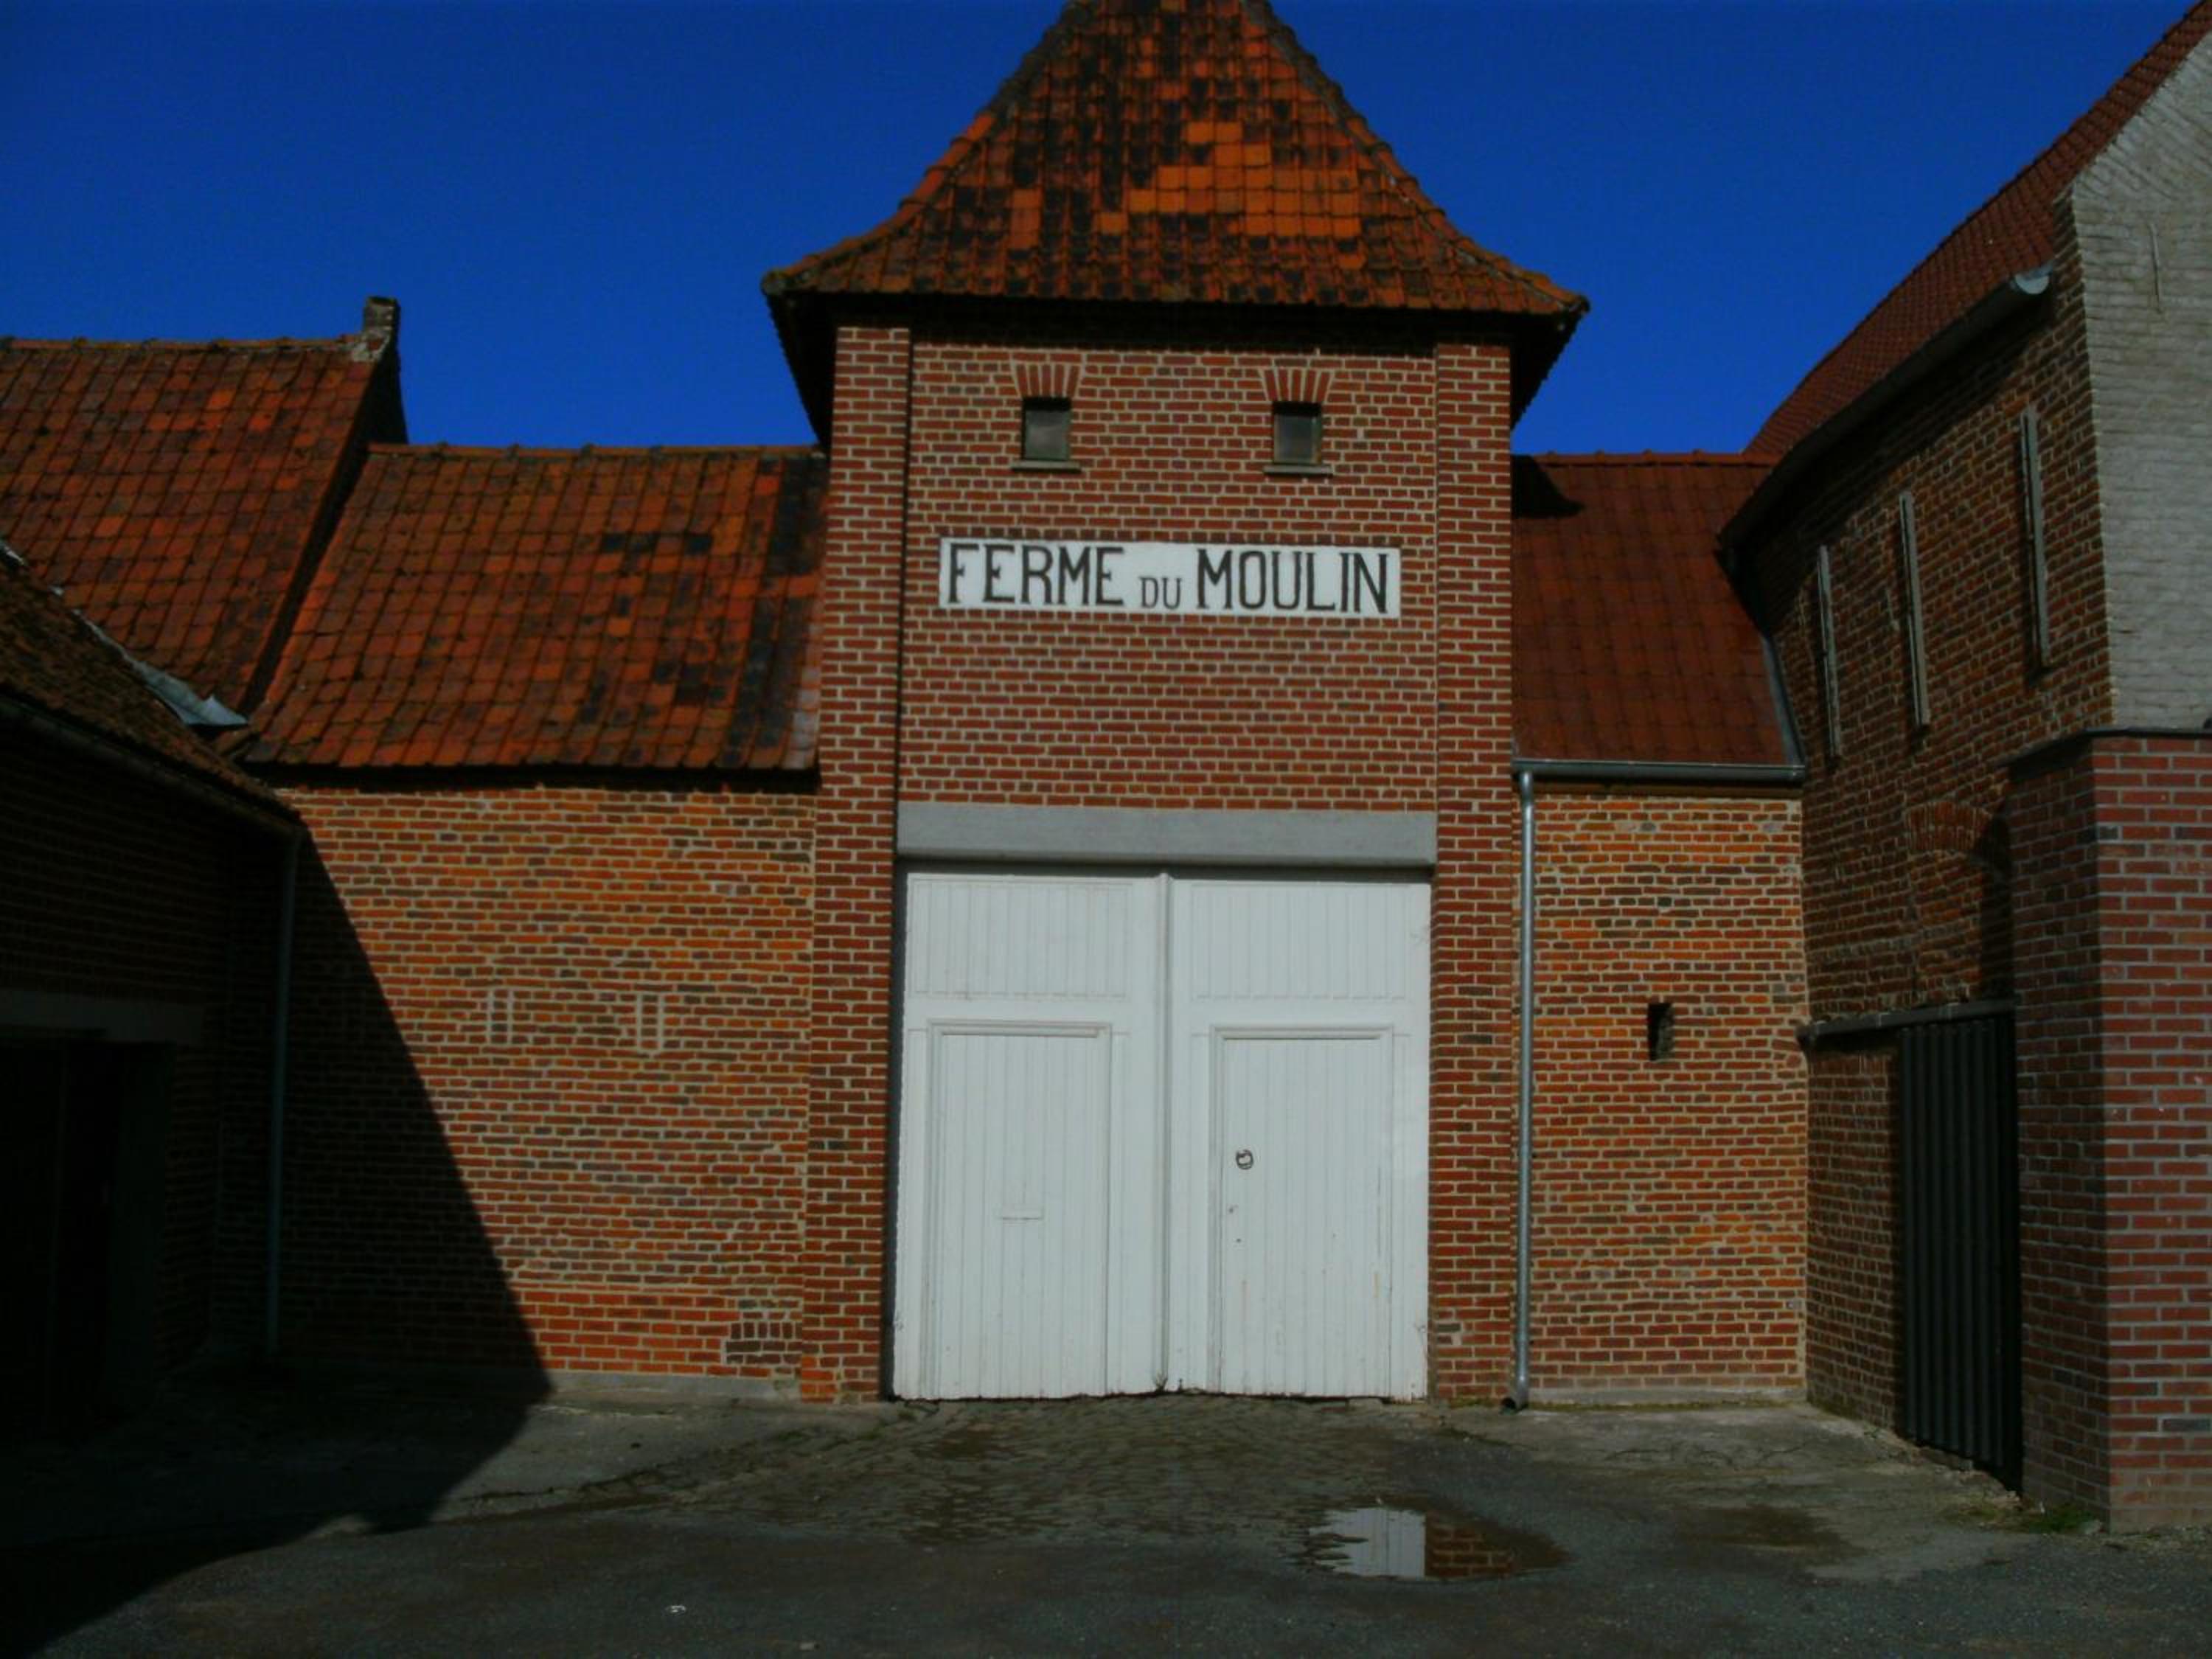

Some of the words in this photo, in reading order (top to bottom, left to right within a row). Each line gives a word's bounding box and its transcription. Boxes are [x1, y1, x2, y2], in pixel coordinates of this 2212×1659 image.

[947, 543, 1125, 607] FERME
[1139, 576, 1182, 610] DU
[1196, 549, 1388, 613] MOULIN
